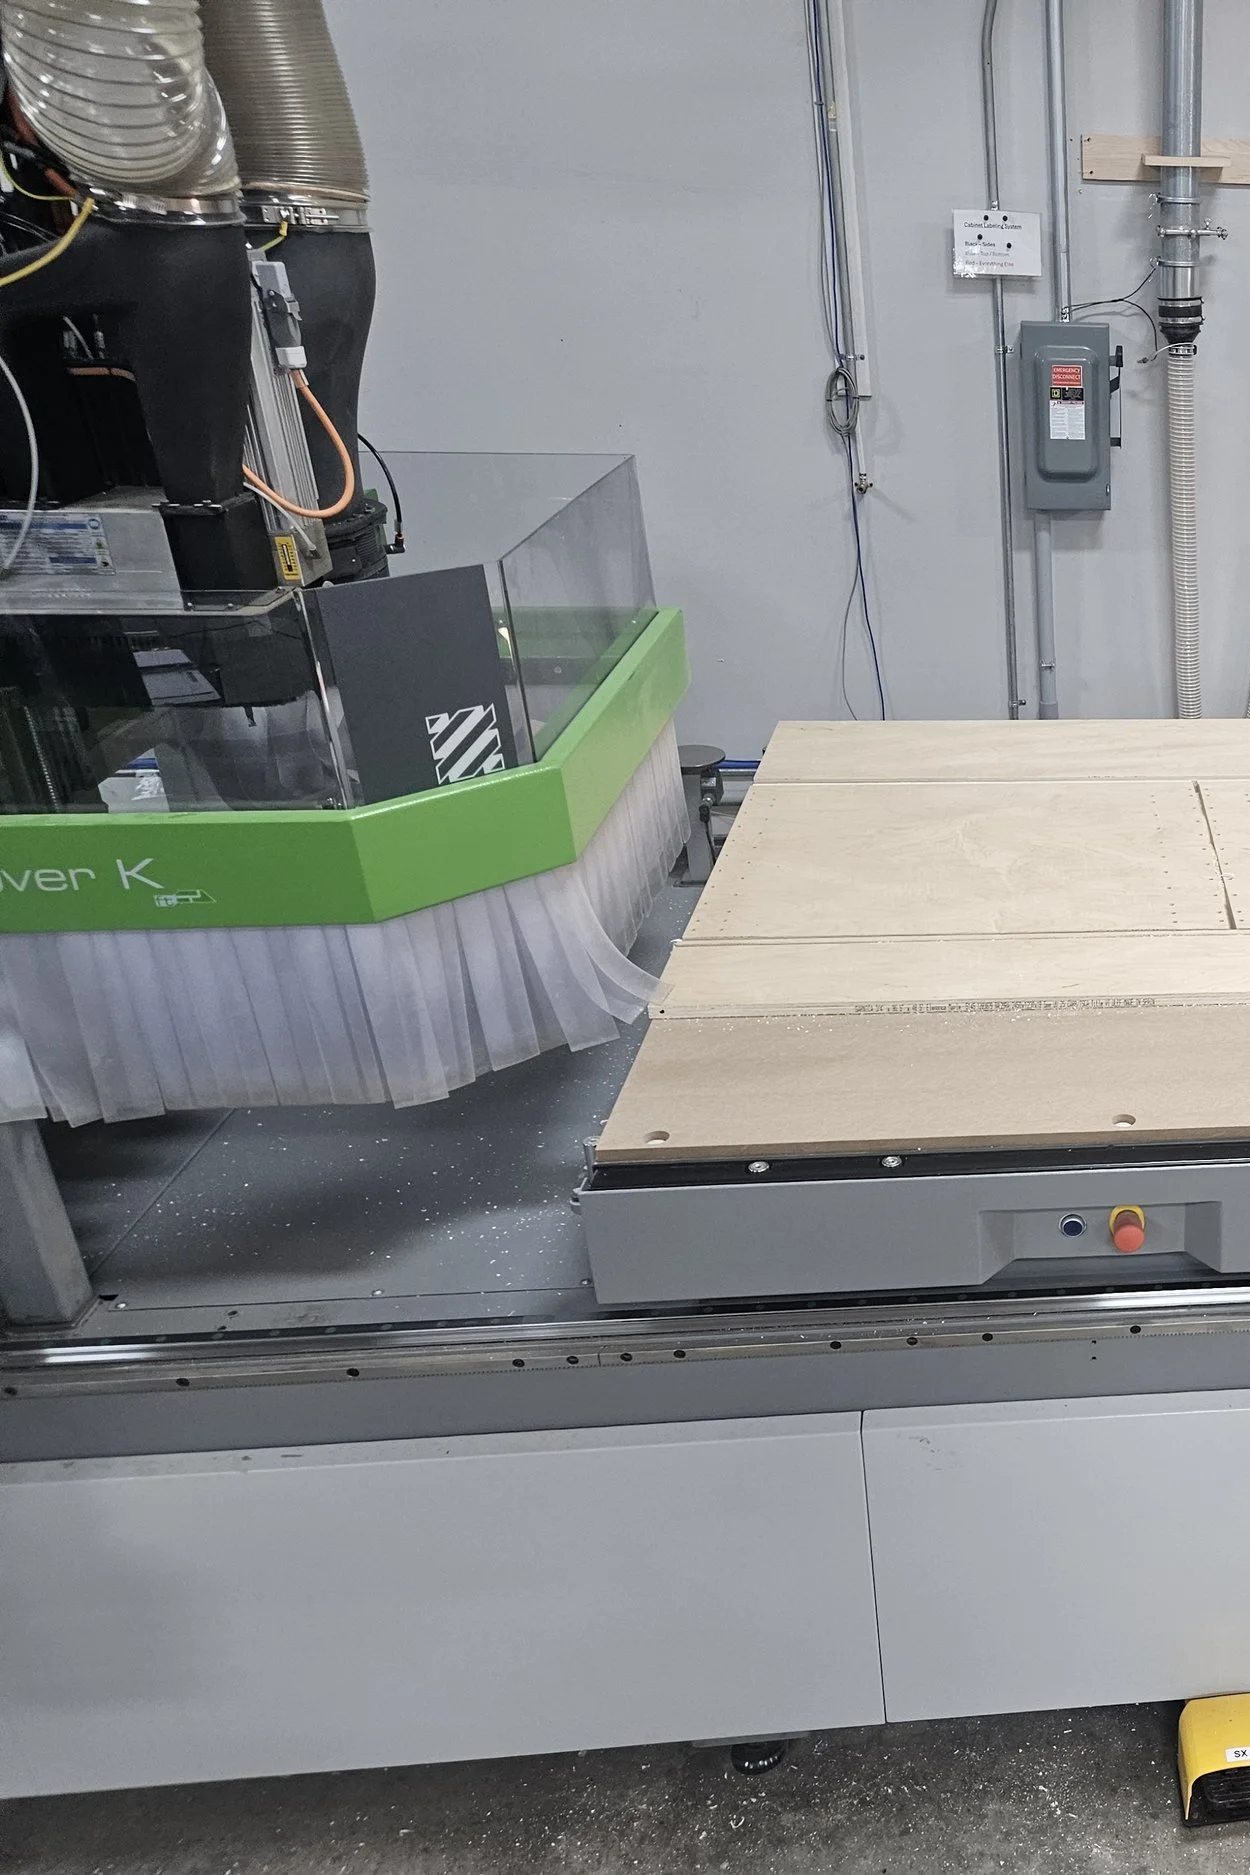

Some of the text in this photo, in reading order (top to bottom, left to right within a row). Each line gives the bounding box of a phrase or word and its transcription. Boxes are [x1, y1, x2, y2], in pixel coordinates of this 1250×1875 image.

[983, 222, 1004, 230] Labeling
[0, 858, 165, 892] ver K
[1234, 1749, 1248, 1758] SX
